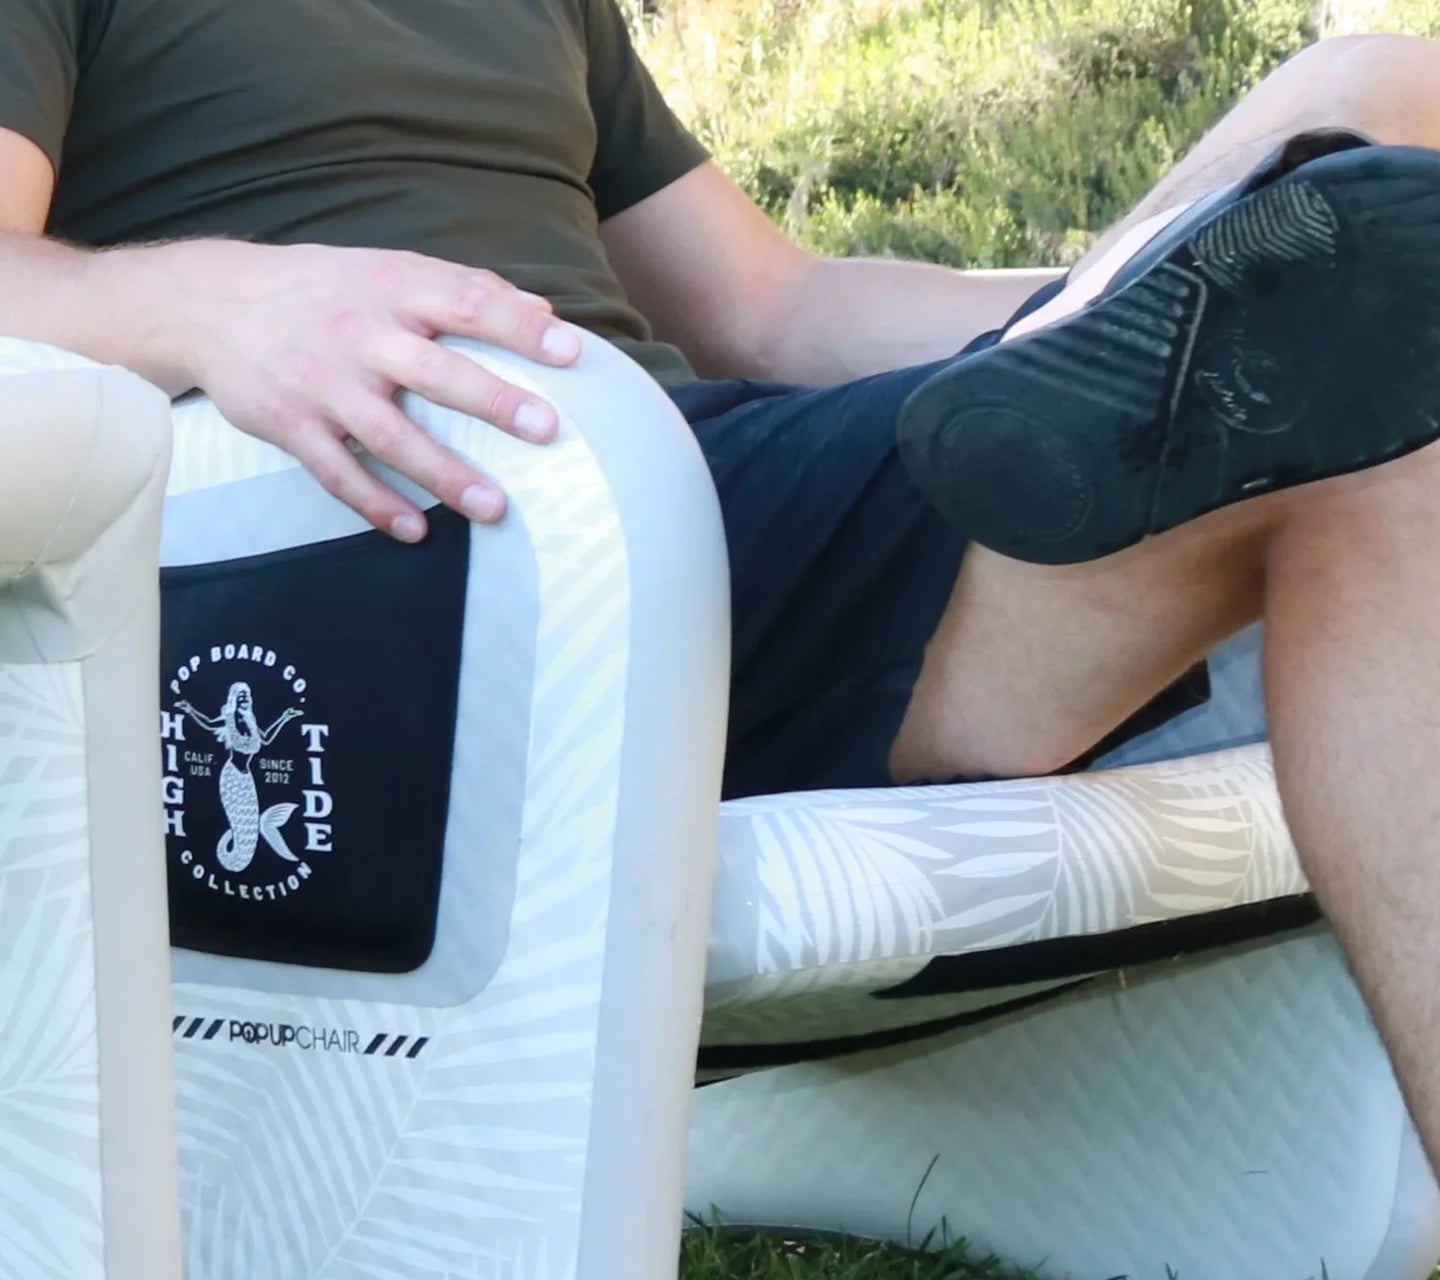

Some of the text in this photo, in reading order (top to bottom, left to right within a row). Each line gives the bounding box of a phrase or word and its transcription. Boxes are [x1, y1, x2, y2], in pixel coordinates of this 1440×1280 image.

[170, 643, 307, 703] POP BOARD CO.
[161, 710, 187, 837] HIGH
[190, 765, 212, 777] USA
[259, 758, 294, 771] SINCE
[264, 772, 290, 785] 2012
[301, 723, 333, 852] TIDE
[180, 850, 312, 901] COLLECTION
